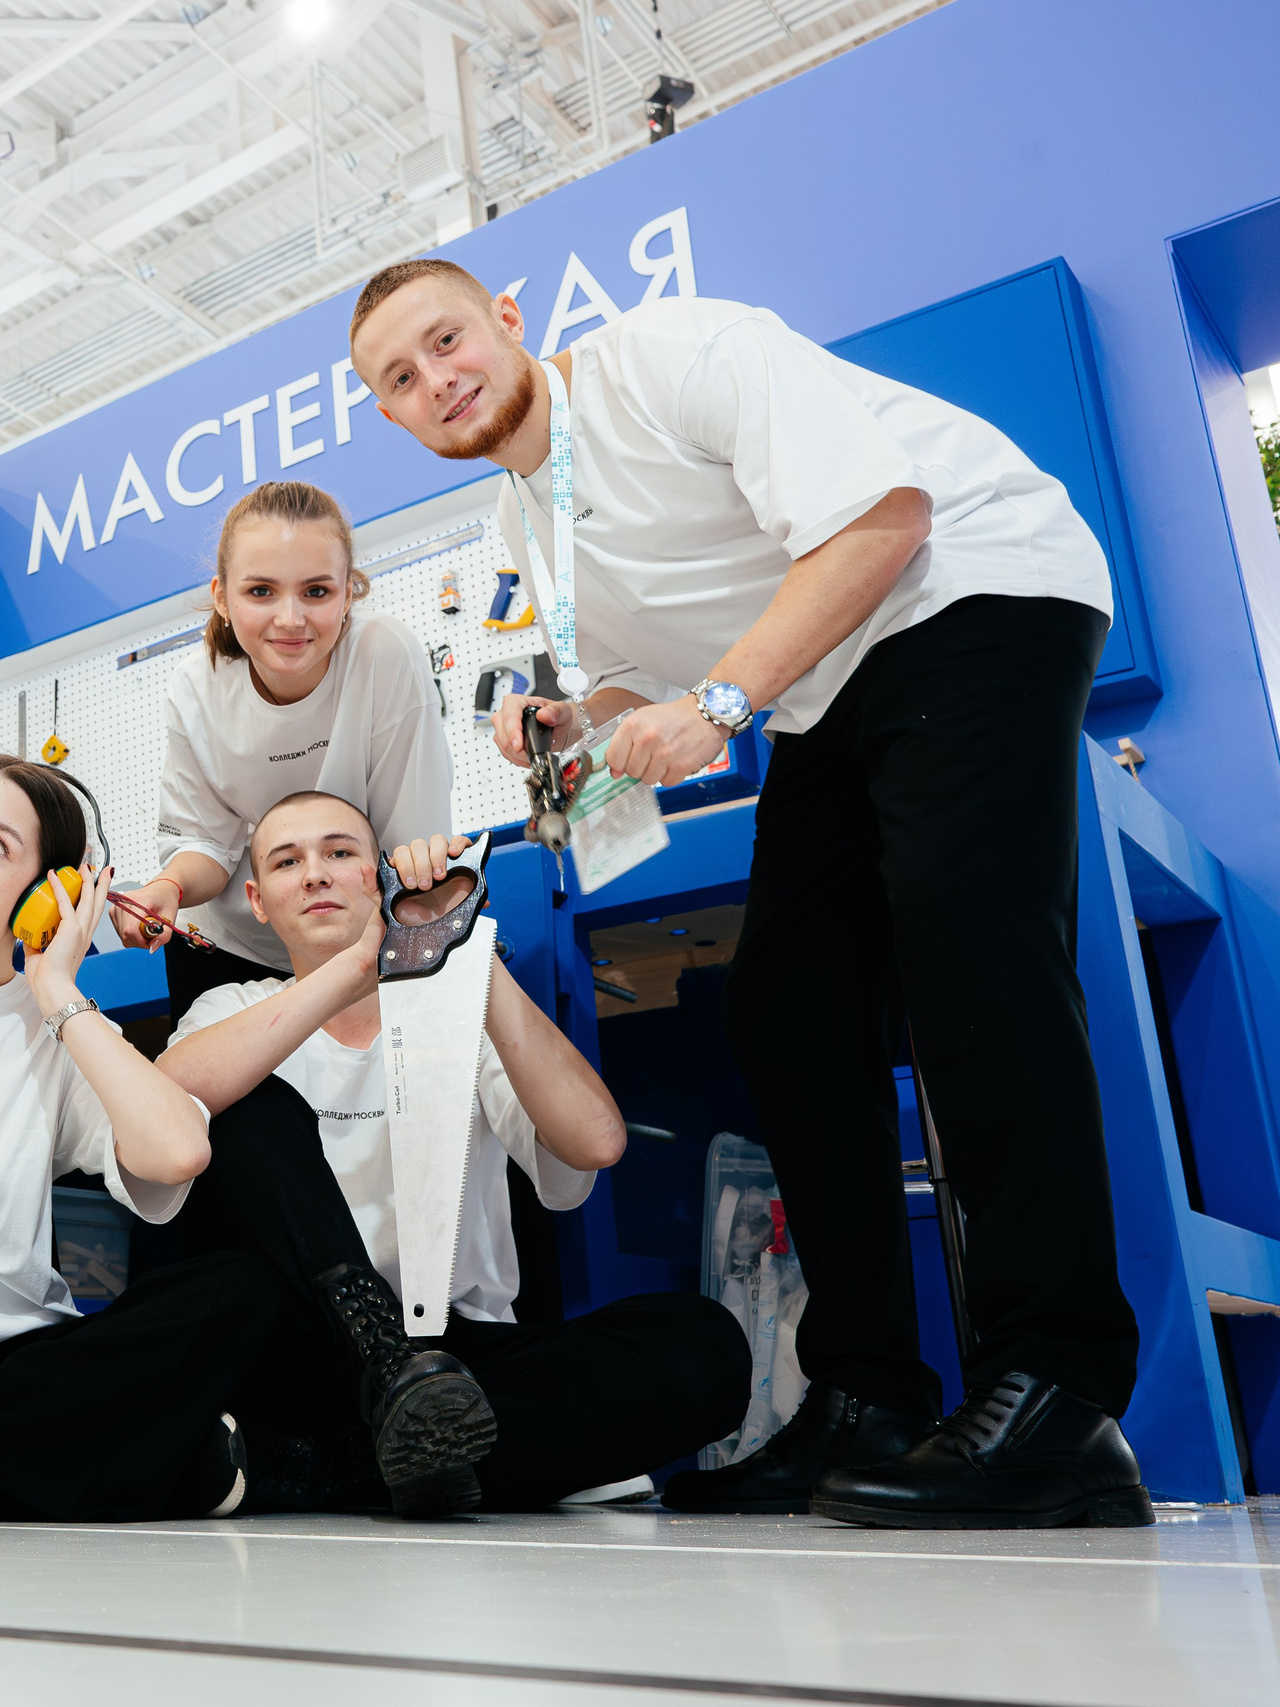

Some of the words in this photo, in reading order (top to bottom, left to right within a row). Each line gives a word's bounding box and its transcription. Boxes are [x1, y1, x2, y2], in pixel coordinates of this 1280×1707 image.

[27, 206, 698, 576] МАСТЕРАЯ
[268, 750, 307, 762] КОЛЛЕДЖИ
[308, 740, 330, 754] МОСК
